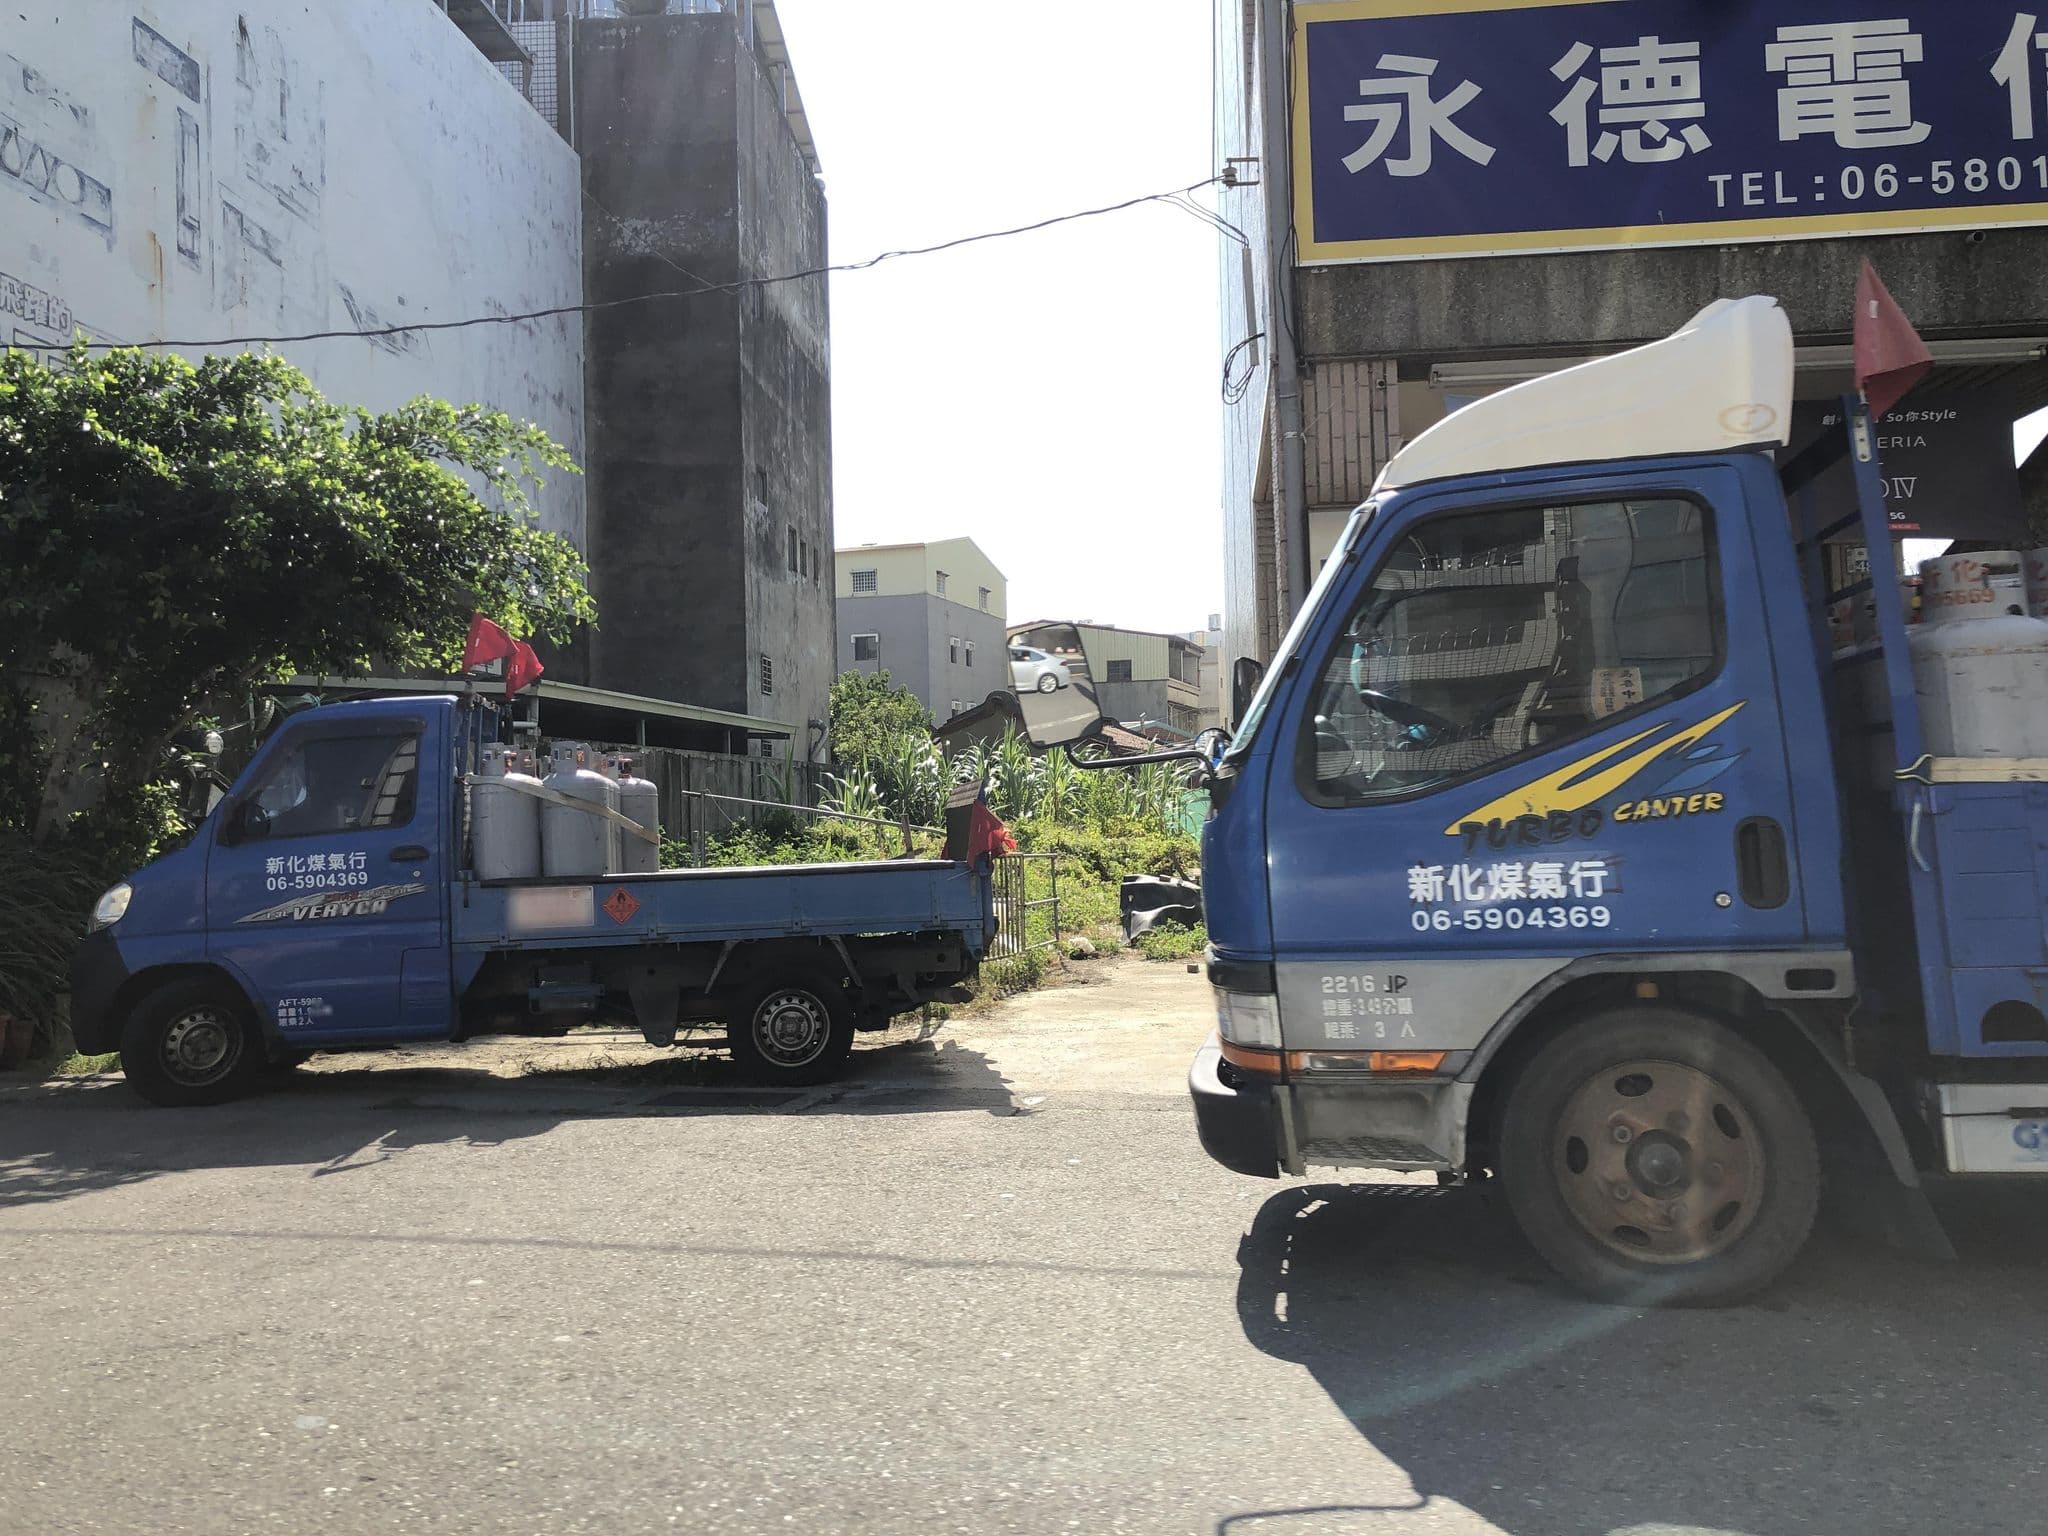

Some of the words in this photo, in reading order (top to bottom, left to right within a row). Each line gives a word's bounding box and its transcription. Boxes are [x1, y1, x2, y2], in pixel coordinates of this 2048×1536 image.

[1877, 435, 1927, 449] ERIA
[1889, 512, 1906, 520] 5G
[1459, 809, 1602, 849] TURBO
[1612, 793, 1725, 822] CANTER
[265, 852, 367, 876] 新化煤氣行
[266, 872, 369, 891] 06-5904369
[1407, 861, 1609, 902] 新化煤氣行
[293, 899, 388, 921] VERYCA
[1411, 906, 1611, 931] 06-5904369
[1321, 974, 1376, 994] 2216
